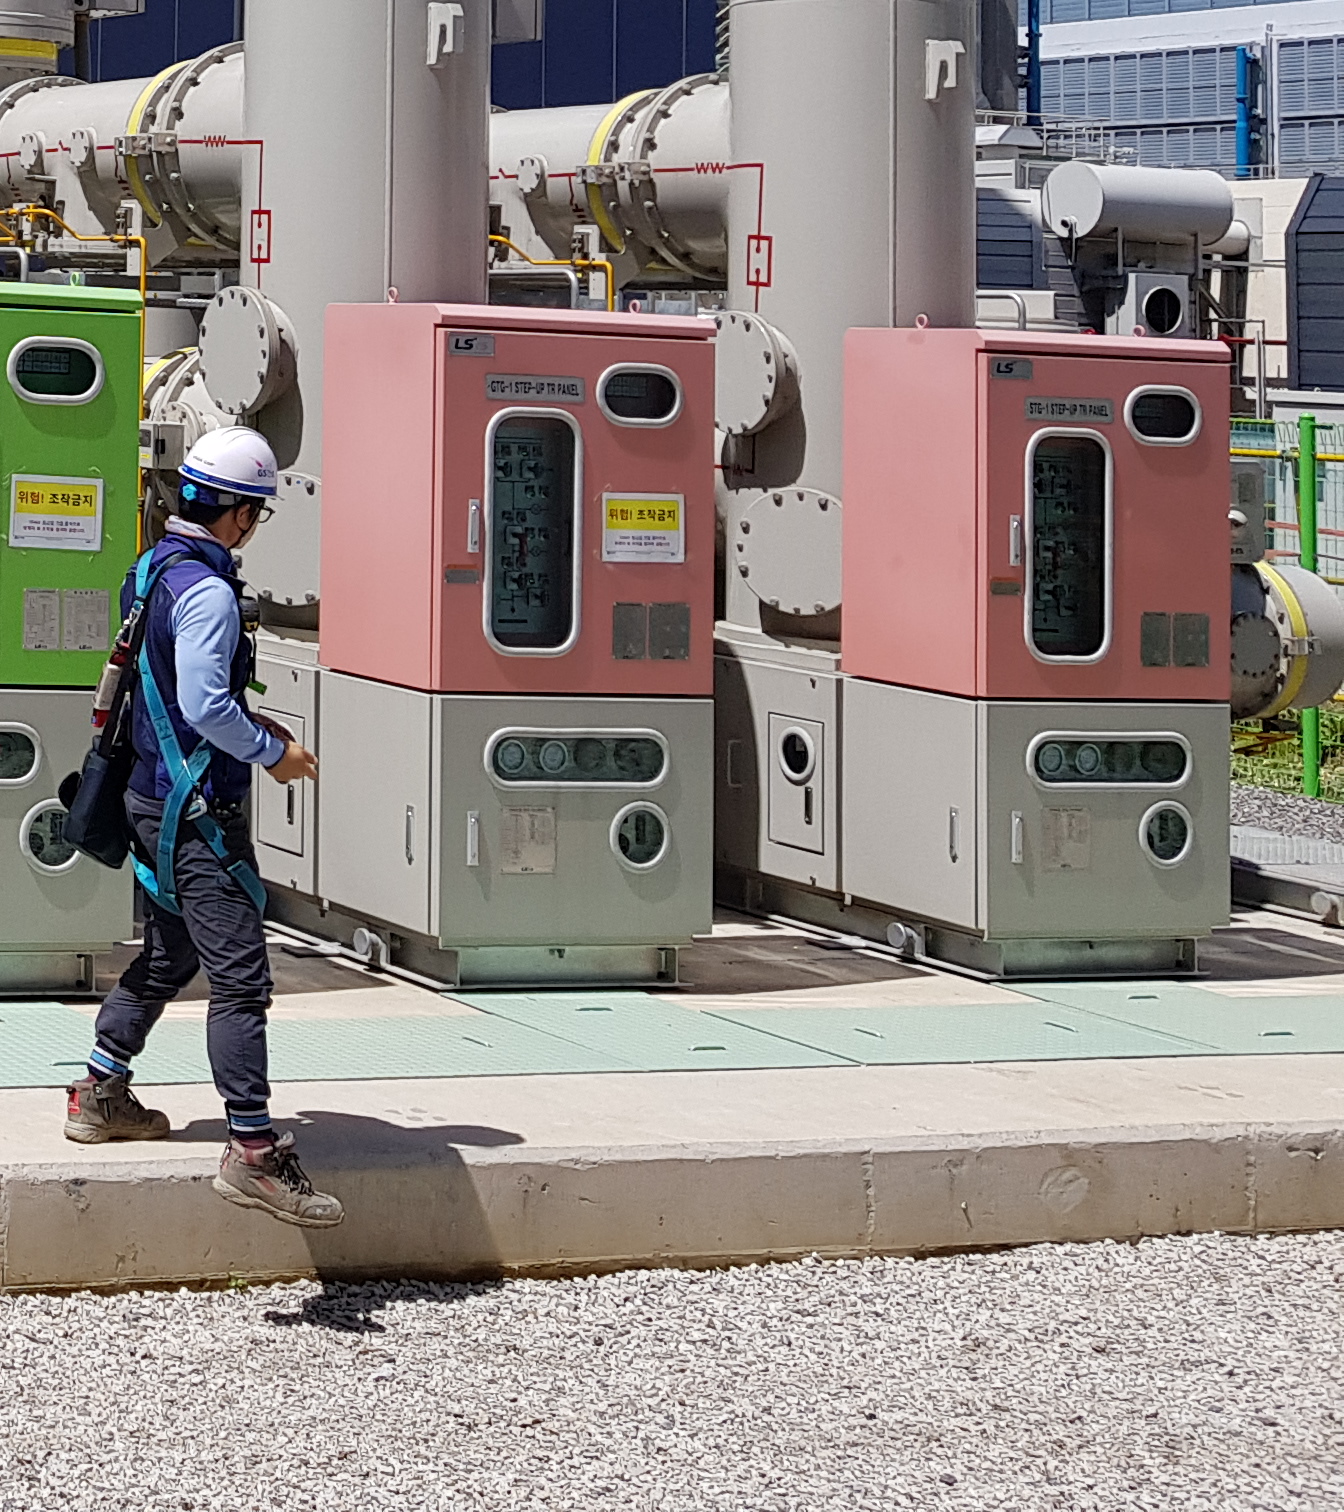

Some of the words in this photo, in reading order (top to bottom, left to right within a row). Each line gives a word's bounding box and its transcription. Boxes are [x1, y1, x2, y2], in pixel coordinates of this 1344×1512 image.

[557, 383, 579, 396] PANEL
[49, 493, 92, 507] 조작금지
[637, 509, 675, 522] 조작금지
